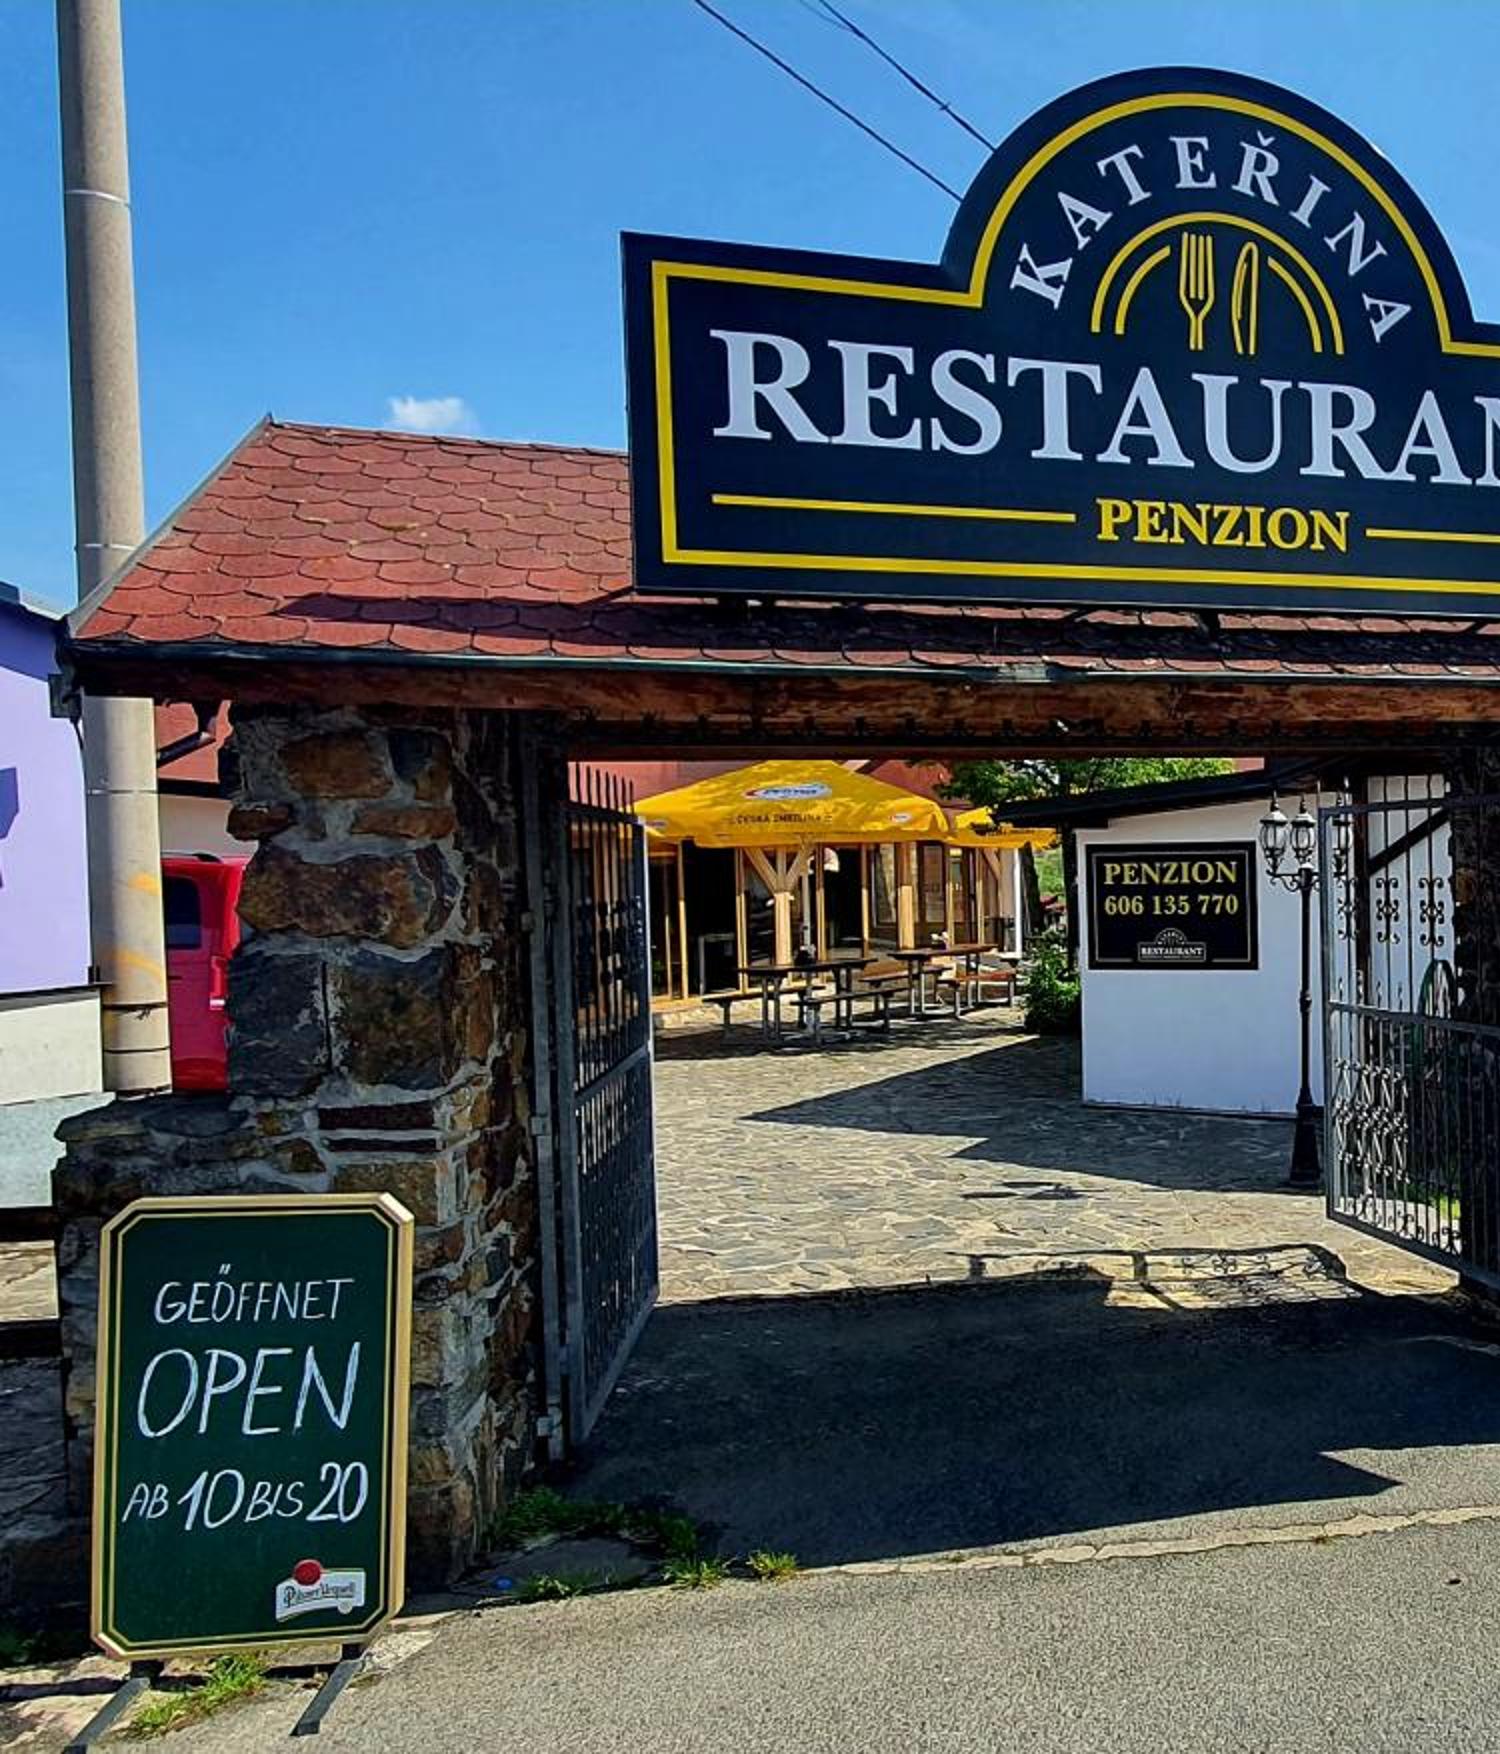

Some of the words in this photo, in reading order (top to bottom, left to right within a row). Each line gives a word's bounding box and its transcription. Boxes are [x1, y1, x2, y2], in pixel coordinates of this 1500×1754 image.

[1009, 129, 1413, 343] KATEŘINA
[1095, 497, 1350, 553] PENZION
[1103, 861, 1238, 885] PENZION
[1104, 896, 1145, 915] 606
[1152, 895, 1191, 915] 135
[1198, 895, 1239, 915] 770
[154, 1264, 354, 1324] GEÖFFNET
[137, 1341, 361, 1438] OPEN
[122, 1484, 168, 1523] AB
[177, 1469, 245, 1531] 10
[245, 1480, 304, 1522] BIS
[306, 1461, 369, 1523] 20
